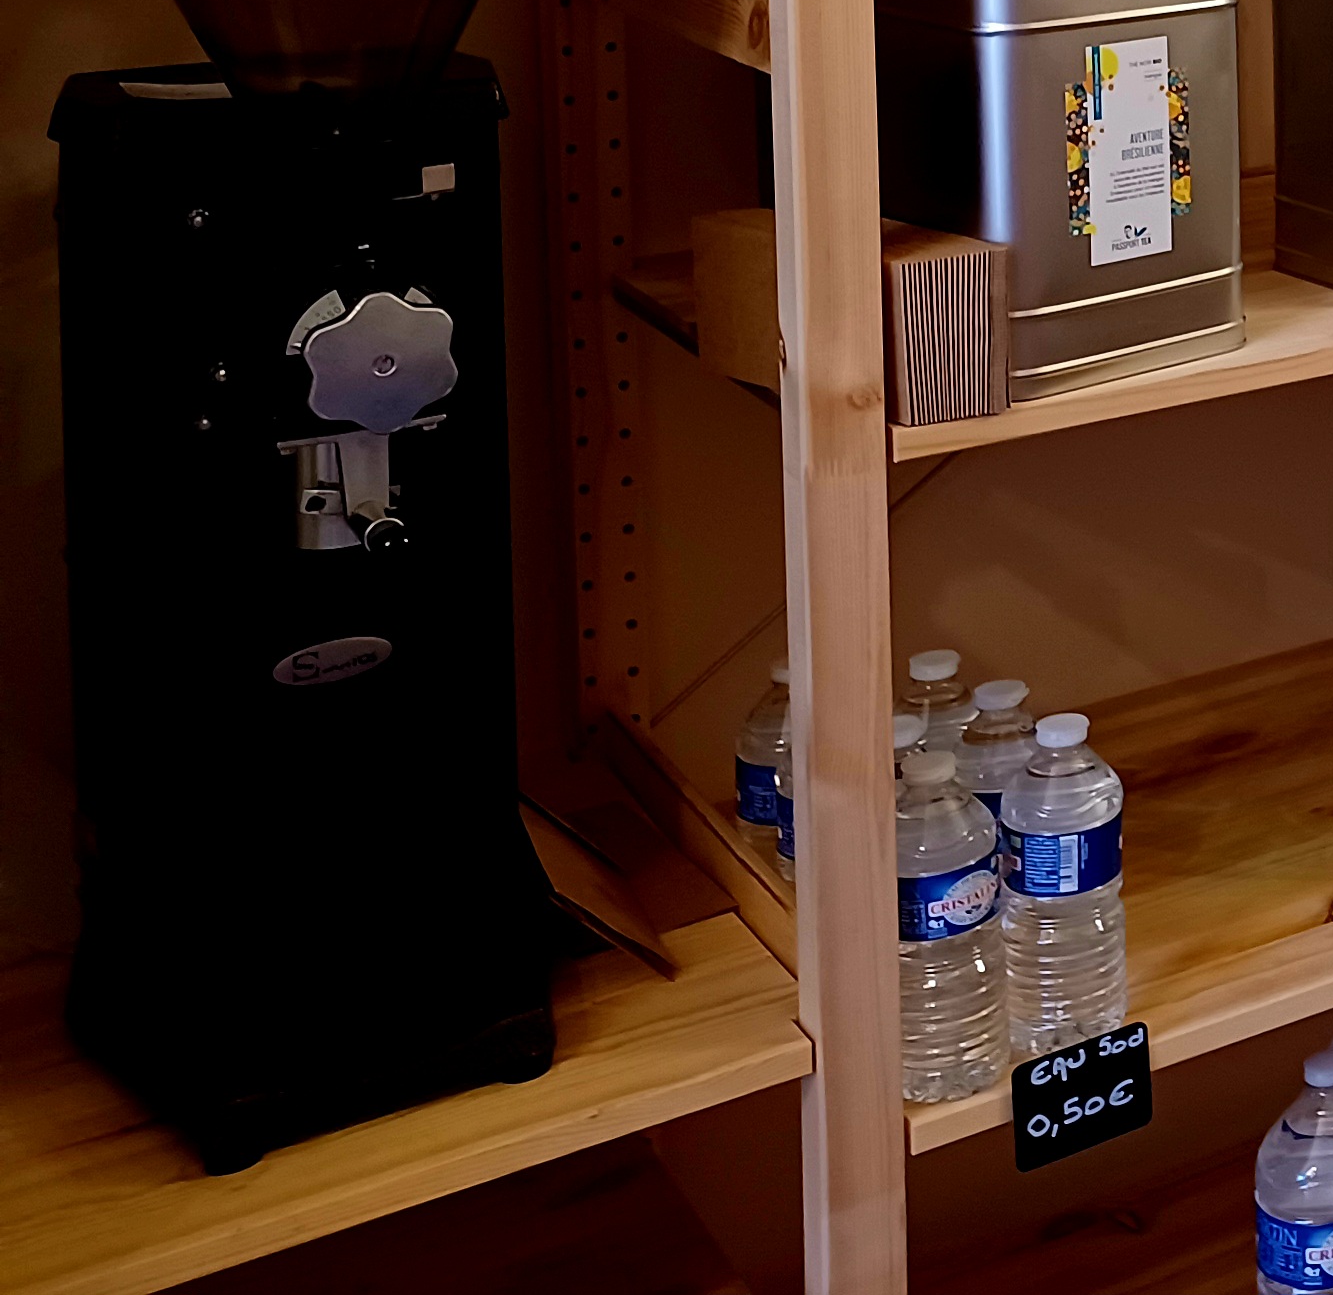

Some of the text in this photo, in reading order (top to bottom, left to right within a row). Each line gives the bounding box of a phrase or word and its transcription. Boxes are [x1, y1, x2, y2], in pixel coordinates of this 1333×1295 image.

[1129, 128, 1165, 145] AVENTURE
[1121, 142, 1165, 161] BRÉSILIENNE
[1111, 236, 1152, 252] PASSPORT TEA
[1031, 1049, 1086, 1085] EAU
[1026, 1079, 1134, 1138] 0,50€
